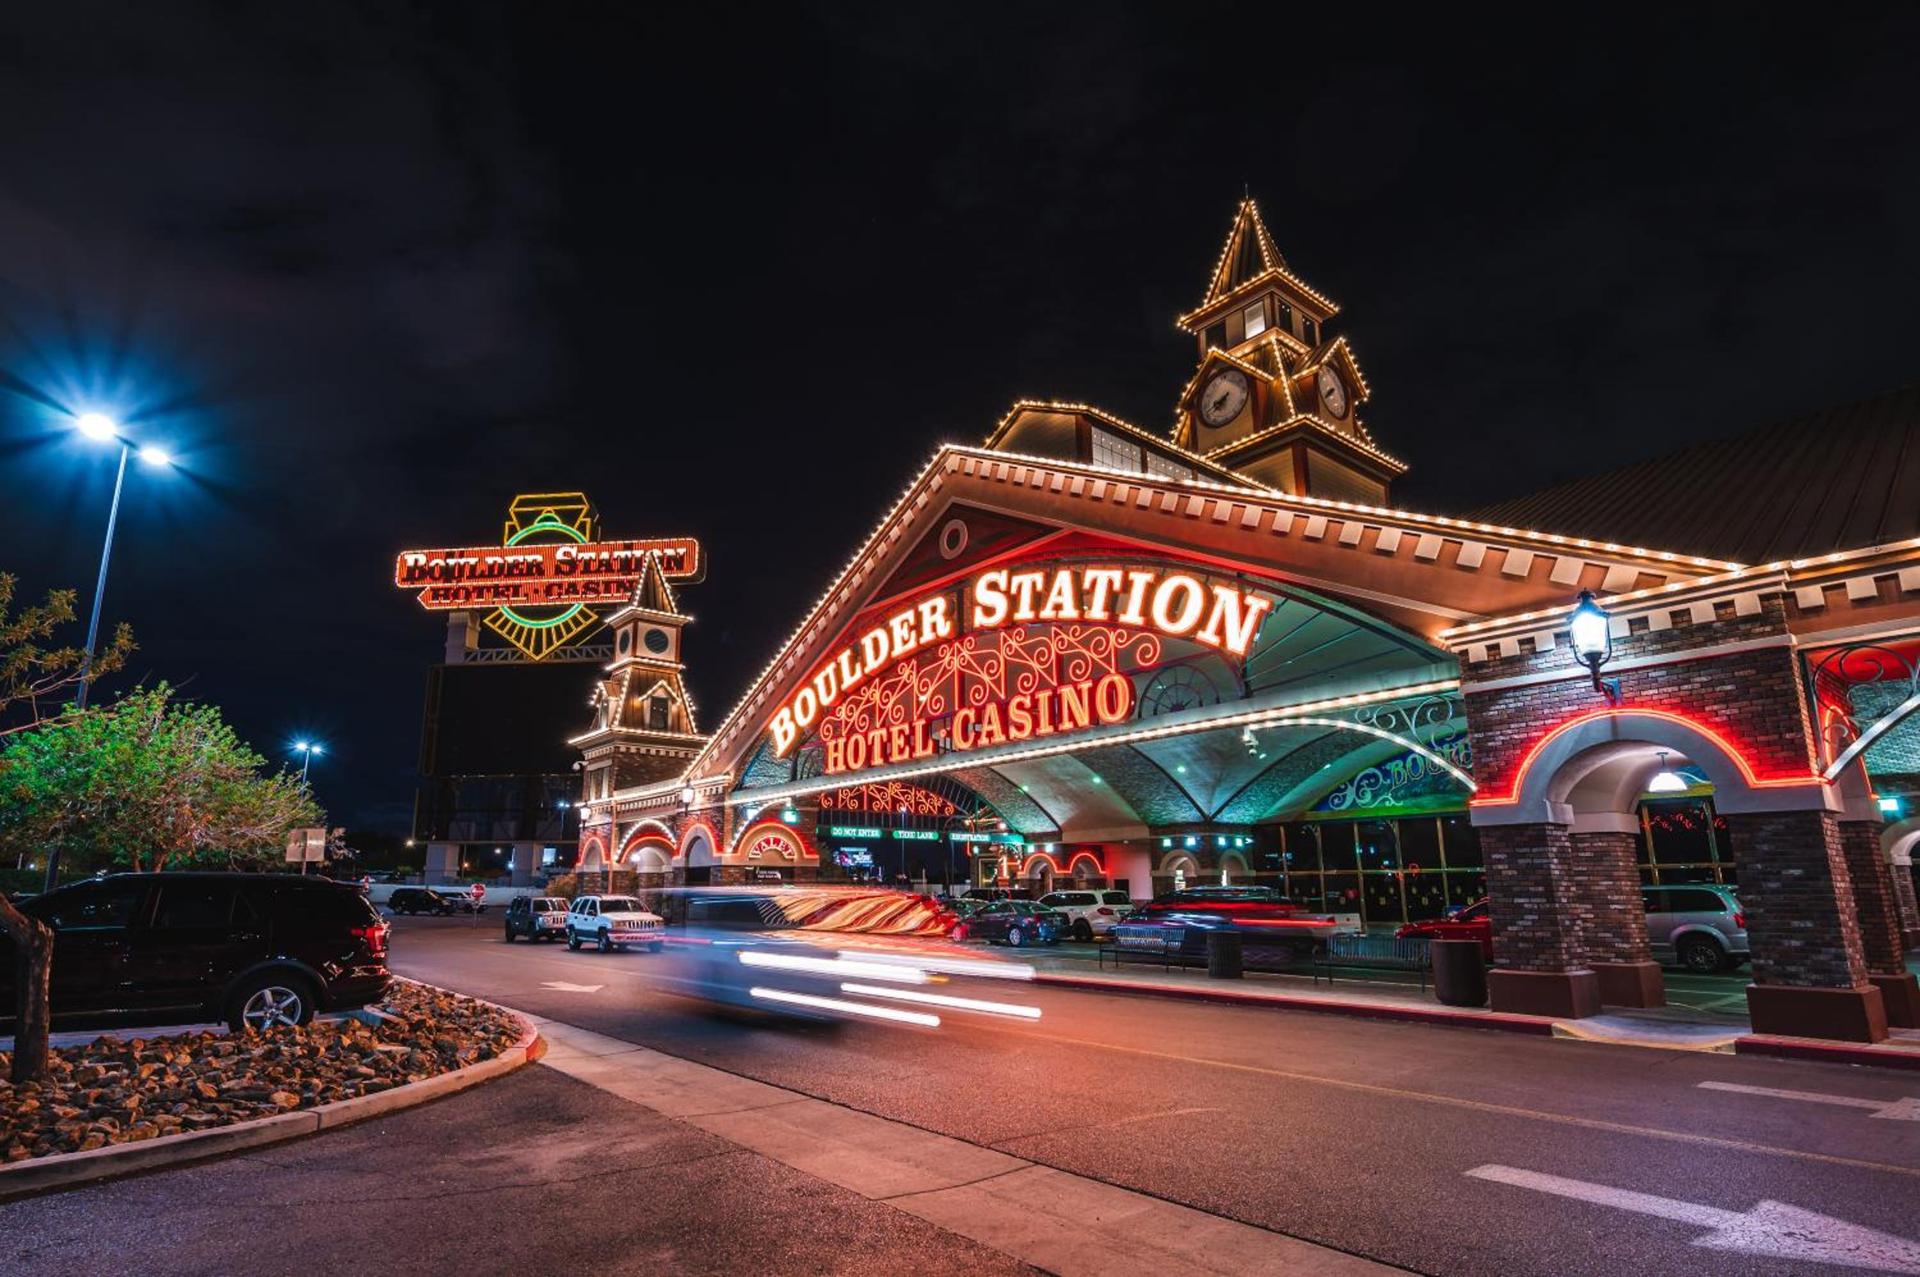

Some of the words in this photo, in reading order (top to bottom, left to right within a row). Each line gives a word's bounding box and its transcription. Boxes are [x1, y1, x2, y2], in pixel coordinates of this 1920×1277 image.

[403, 552, 545, 583] BOULDER
[430, 585, 528, 604] HOTEL
[545, 580, 637, 600] CASIN
[769, 595, 952, 757] BOULDER
[973, 567, 1271, 656] STATION
[824, 721, 936, 774] HOTEL
[952, 673, 1132, 751] CASINO
[750, 836, 796, 858] VALET
